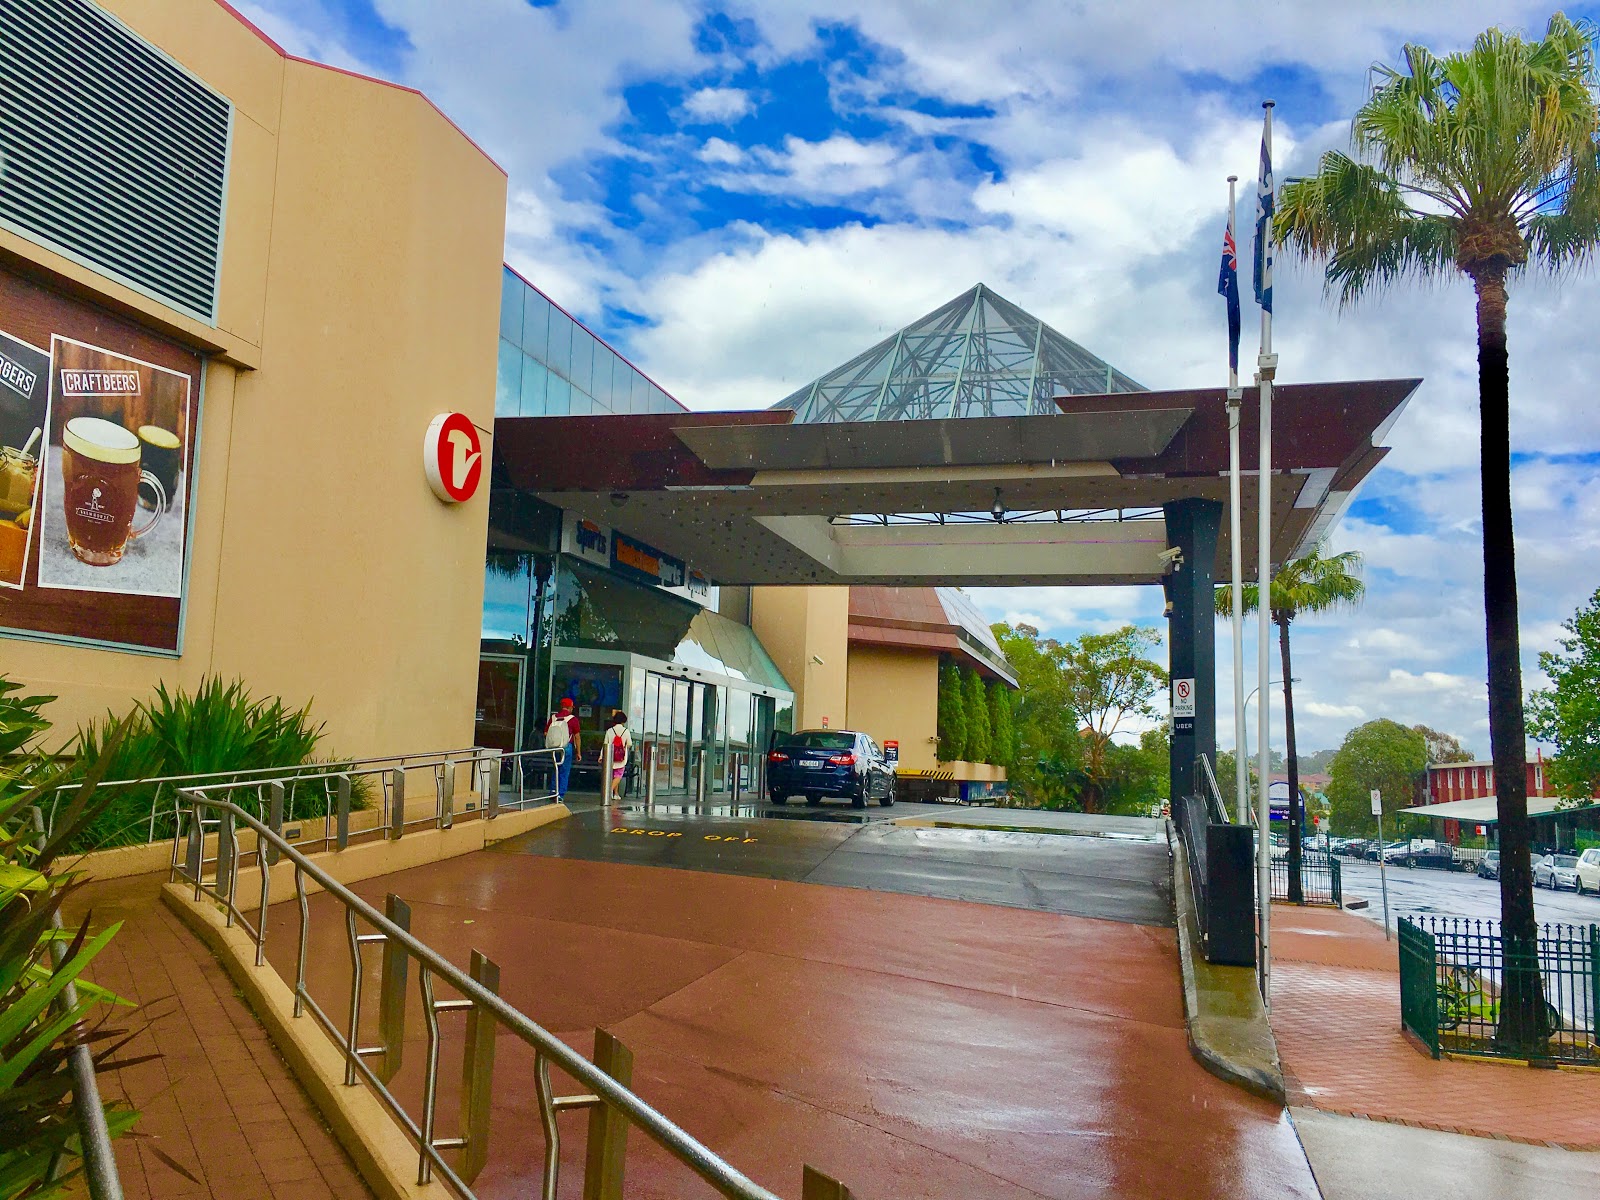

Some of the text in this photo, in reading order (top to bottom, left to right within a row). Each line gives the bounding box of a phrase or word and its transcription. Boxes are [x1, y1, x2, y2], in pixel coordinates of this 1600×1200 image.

[66, 373, 136, 391] CRAFT BEERS
[611, 827, 758, 843] DROP OFF
